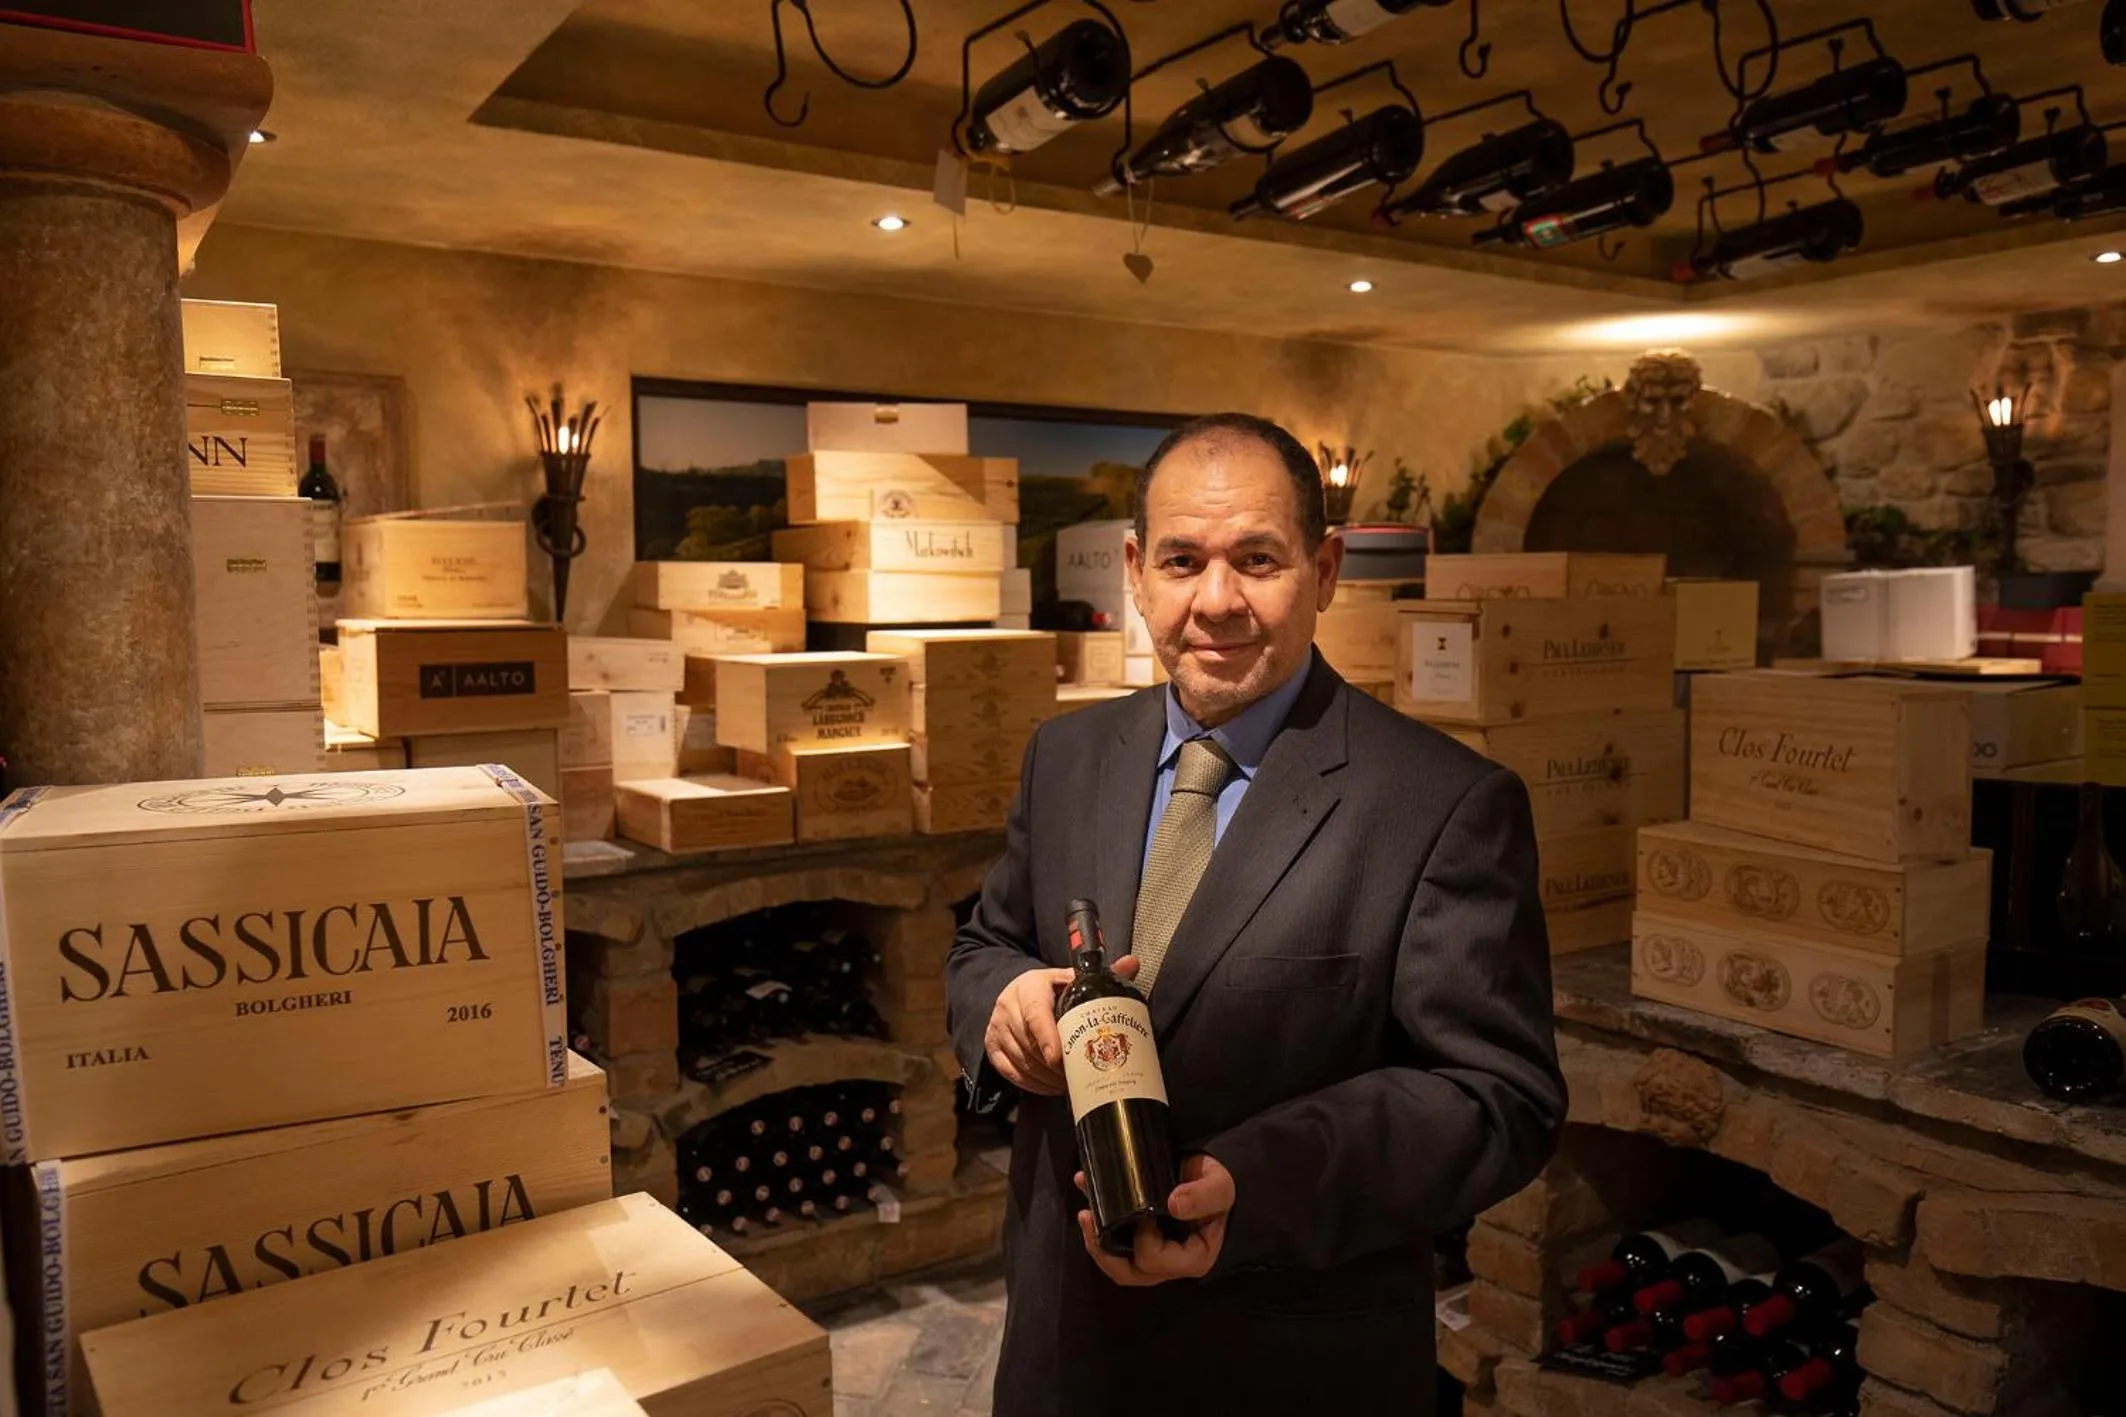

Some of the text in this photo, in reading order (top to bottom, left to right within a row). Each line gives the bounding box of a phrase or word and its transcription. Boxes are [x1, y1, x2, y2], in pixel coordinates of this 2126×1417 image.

[464, 671, 525, 687] AALTO
[1717, 726, 1857, 773] Clos Fourtet
[58, 896, 490, 1003] SASSICAIA
[235, 990, 353, 1017] BOLGHERI
[447, 1003, 493, 1023] 2016
[66, 1046, 150, 1069] ITALIA
[138, 1174, 537, 1319] SASSICAIA
[228, 1271, 637, 1406] Clos Fourtet
